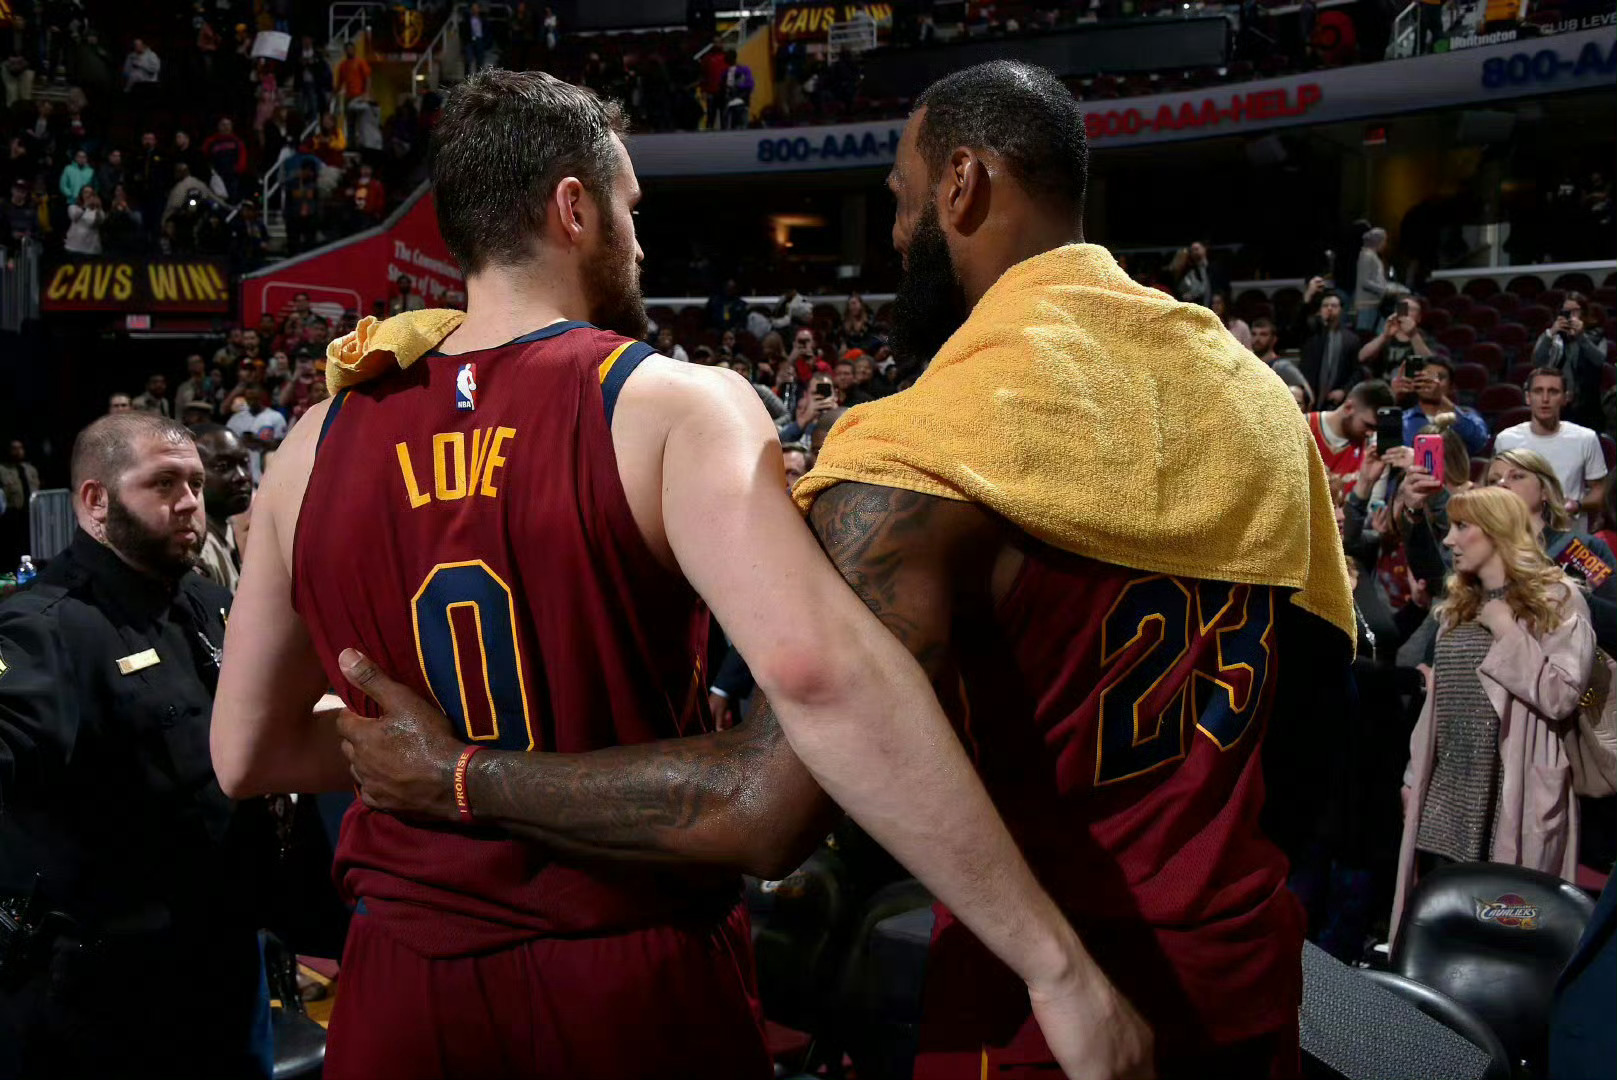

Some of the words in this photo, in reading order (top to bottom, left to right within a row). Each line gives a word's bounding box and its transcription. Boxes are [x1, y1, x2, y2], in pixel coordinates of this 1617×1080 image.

[780, 7, 836, 34] CAVS
[1450, 30, 1517, 49] Huntington
[1541, 19, 1578, 34] CLUB
[1085, 85, 1321, 137] 800-AAA-HELP
[48, 264, 132, 300] CAVS
[148, 264, 229, 300] WIN!
[458, 400, 471, 410] NBA
[396, 426, 517, 509] LOVE
[1565, 538, 1612, 582] TIPOFF
[411, 558, 535, 752] 0
[1093, 574, 1275, 787] 23
[455, 752, 471, 807] PROMISE
[1481, 903, 1537, 921] CAVALIERS
